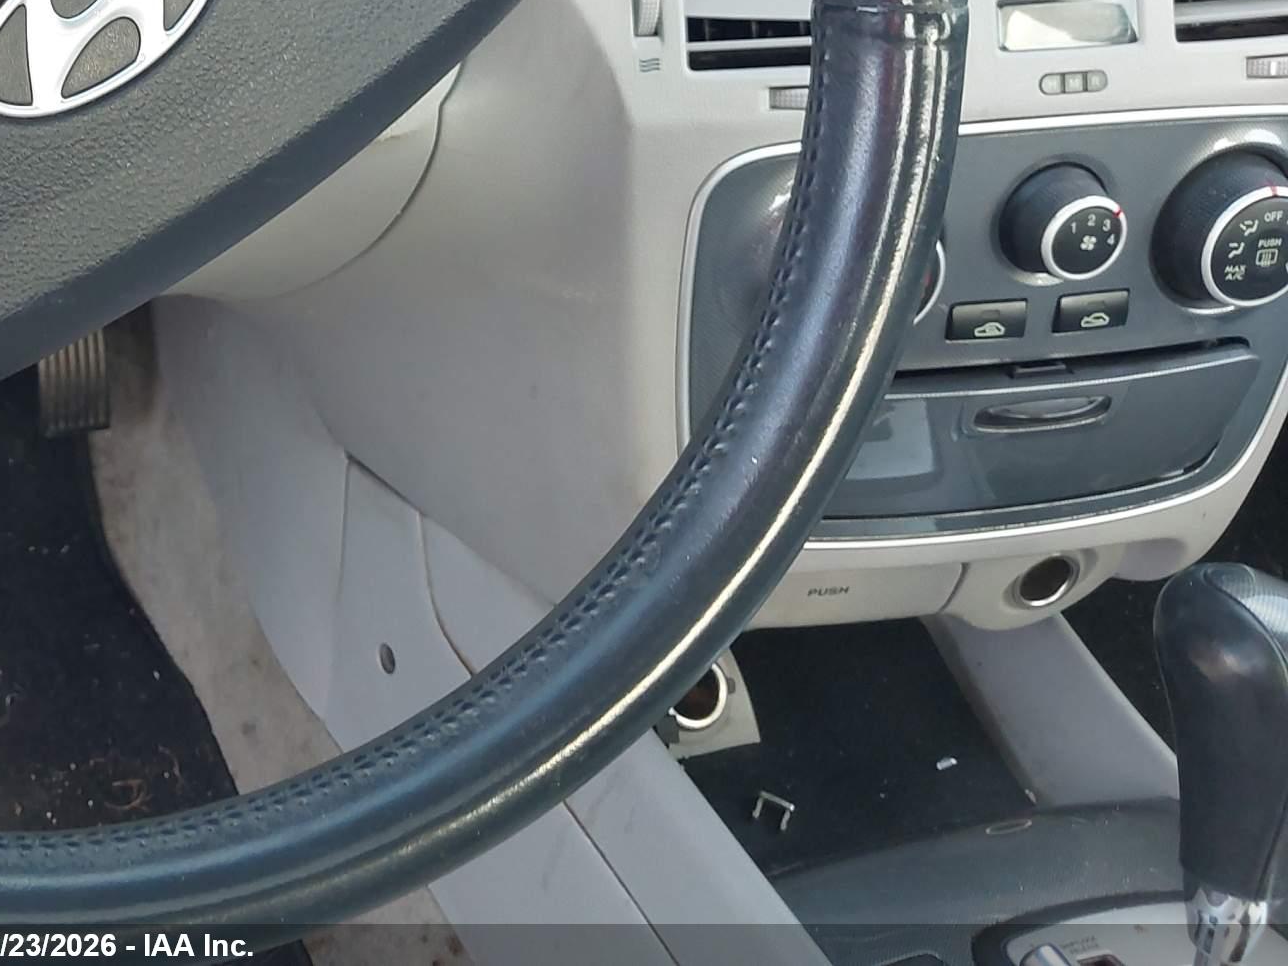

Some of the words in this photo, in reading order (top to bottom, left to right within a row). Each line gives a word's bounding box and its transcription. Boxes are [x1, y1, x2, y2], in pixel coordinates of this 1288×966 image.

[1087, 213, 1096, 227] 2
[1263, 209, 1283, 223] OFF
[1070, 221, 1077, 234] 1
[1102, 218, 1111, 232] 3
[1106, 234, 1115, 246] 4
[1257, 237, 1283, 248] PUSH
[1223, 264, 1246, 275] MAX
[1224, 272, 1245, 282] A/C
[807, 586, 850, 597] PUSH
